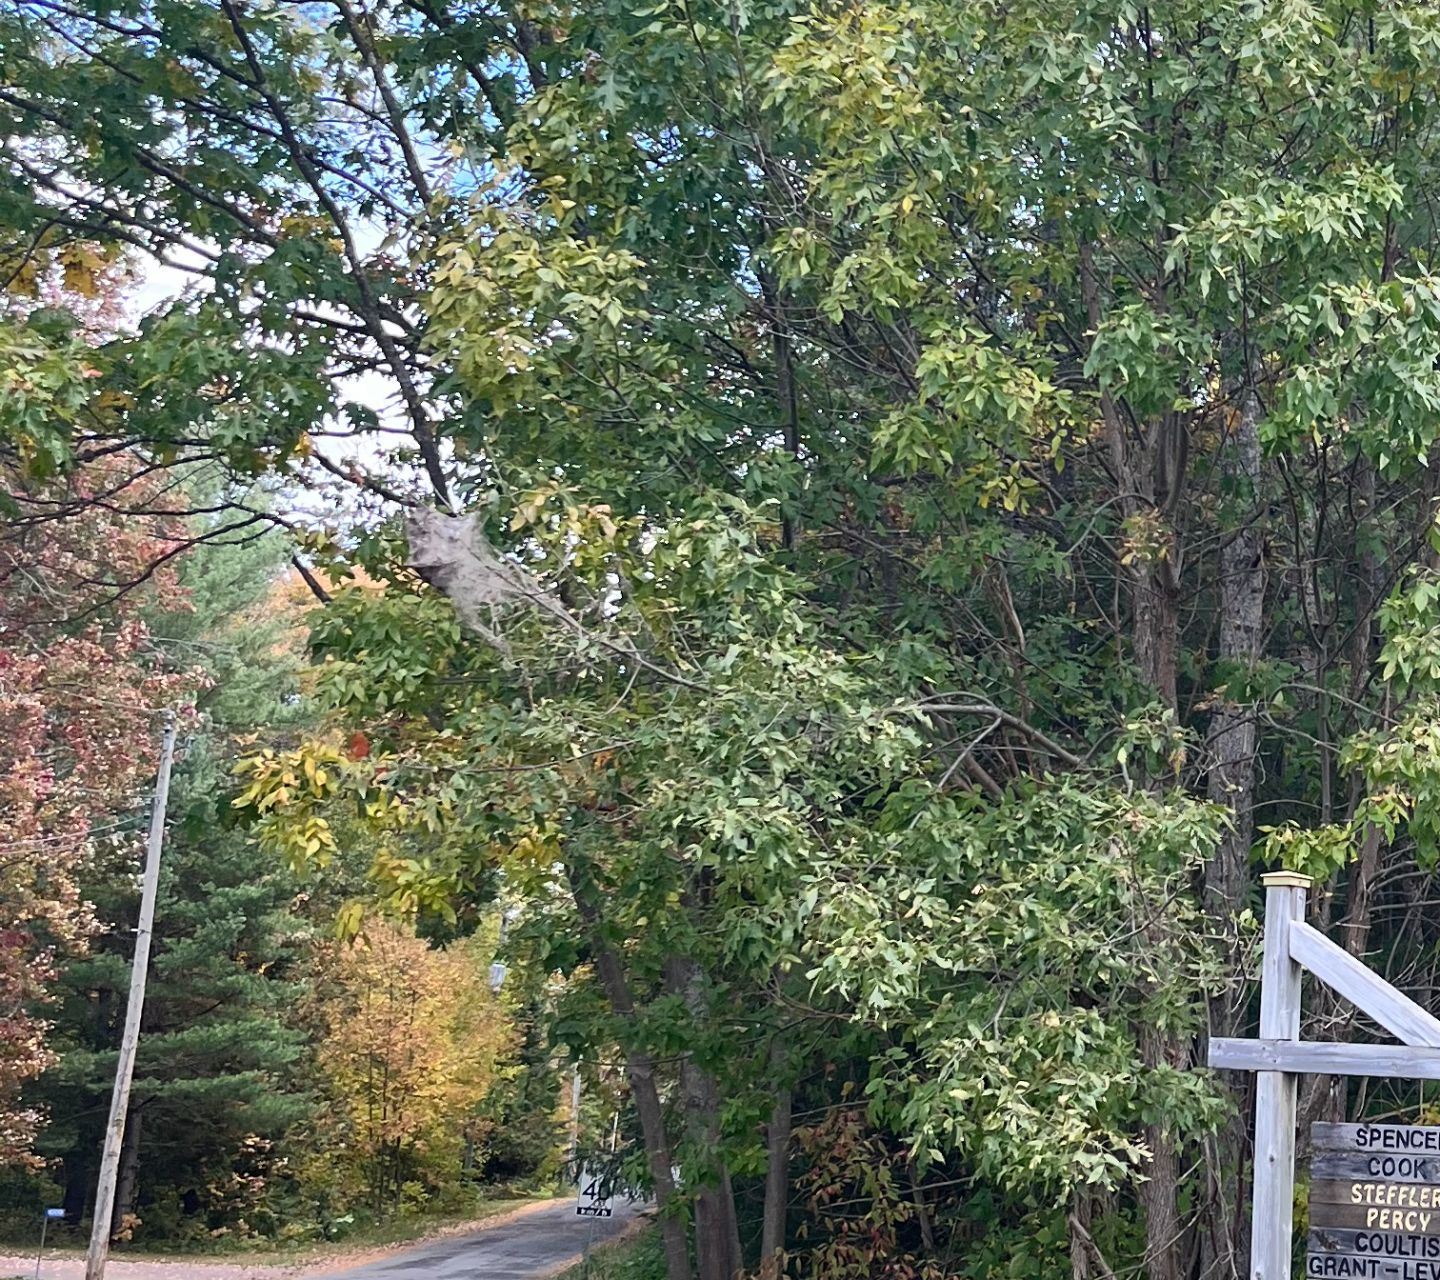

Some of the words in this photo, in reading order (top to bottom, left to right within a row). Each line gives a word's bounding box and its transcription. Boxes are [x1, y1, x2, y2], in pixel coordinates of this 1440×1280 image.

[1367, 1157, 1428, 1179] COOK
[1366, 1208, 1431, 1232] PERCY
[1354, 1232, 1440, 1257] COULTIS
